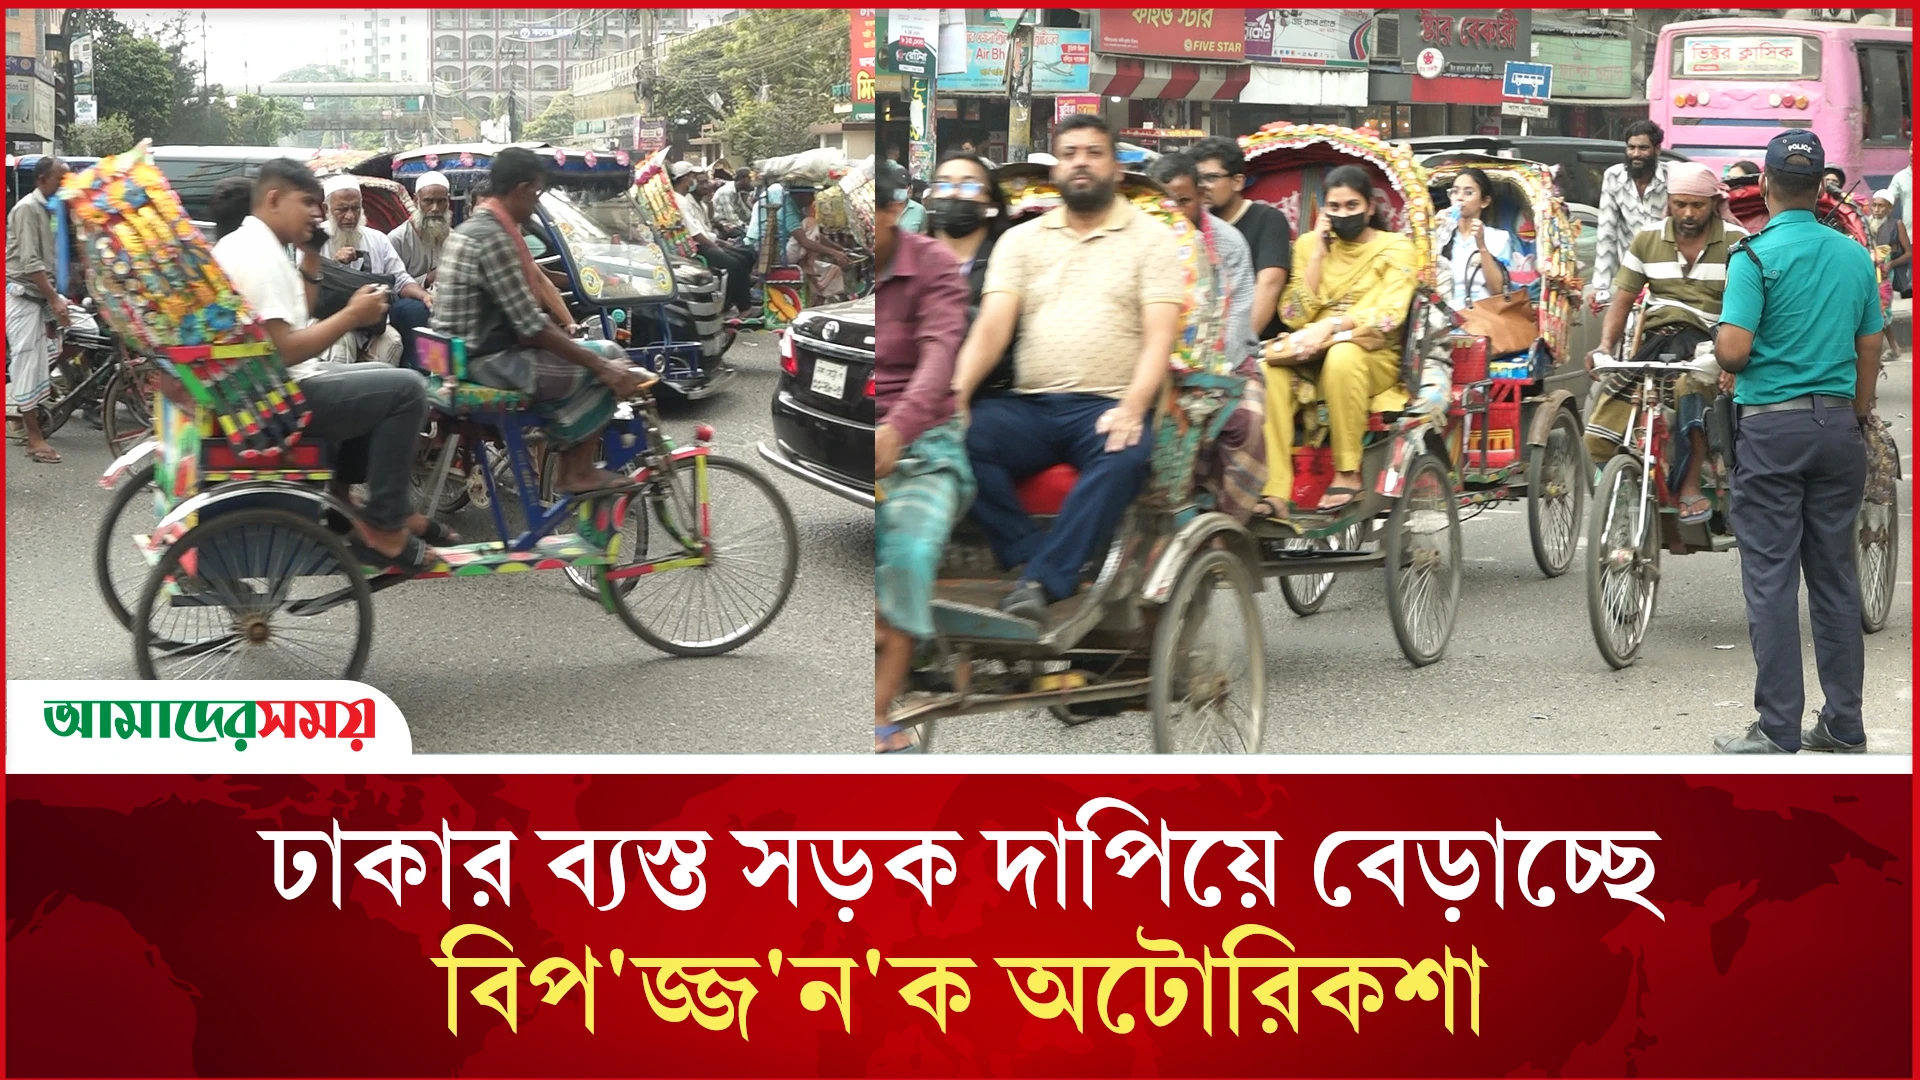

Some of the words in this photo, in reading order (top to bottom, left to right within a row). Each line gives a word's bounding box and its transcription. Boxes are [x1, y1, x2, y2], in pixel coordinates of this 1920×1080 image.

[1459, 8, 1519, 50] বেকারী
[1193, 40, 1215, 52] FIVE
[1217, 41, 1242, 53] STAR
[1691, 42, 1731, 60] ভিক্টর
[1738, 42, 1793, 61] ক্লাসিক
[976, 48, 989, 59] Air
[991, 47, 1005, 60] Bh
[1788, 143, 1812, 153] POLICE
